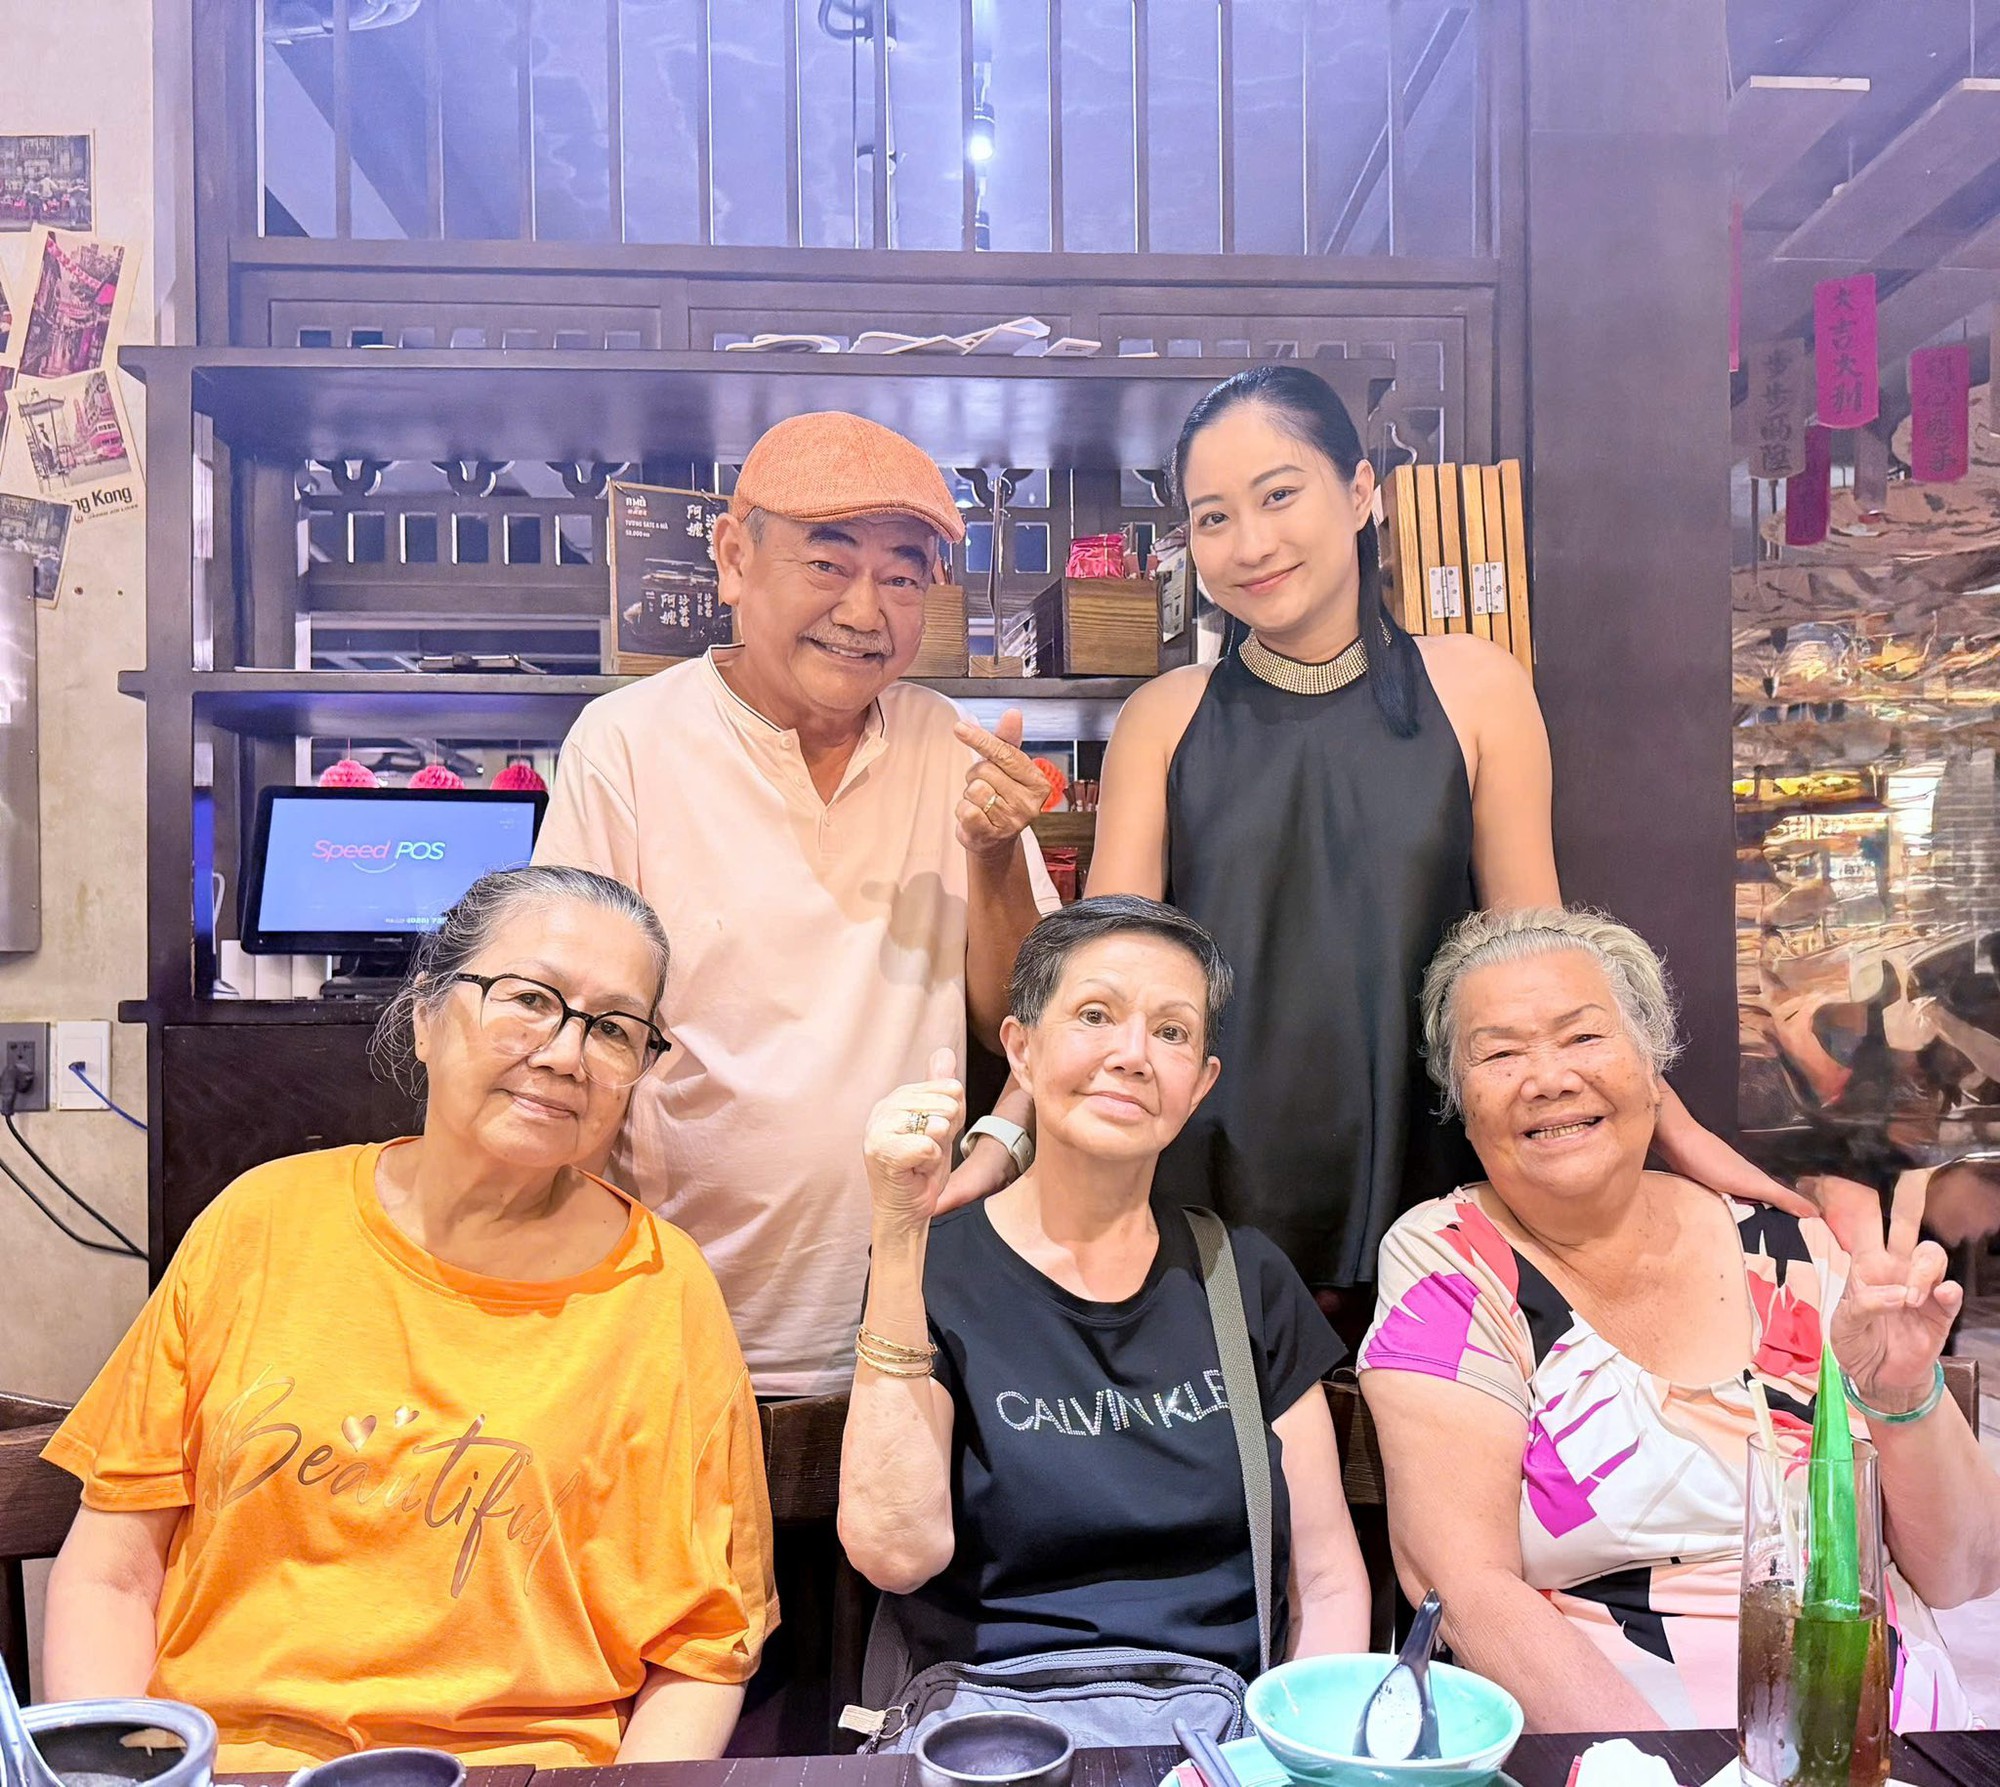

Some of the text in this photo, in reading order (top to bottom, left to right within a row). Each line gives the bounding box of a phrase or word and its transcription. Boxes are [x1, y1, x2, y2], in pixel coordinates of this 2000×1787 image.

[1829, 286, 1864, 413] 大吉大利
[92, 487, 133, 507] Kong
[312, 839, 446, 862] Speed POS
[996, 1368, 1231, 1437] CALVIN KLE
[205, 1365, 579, 1598] Beautiful
